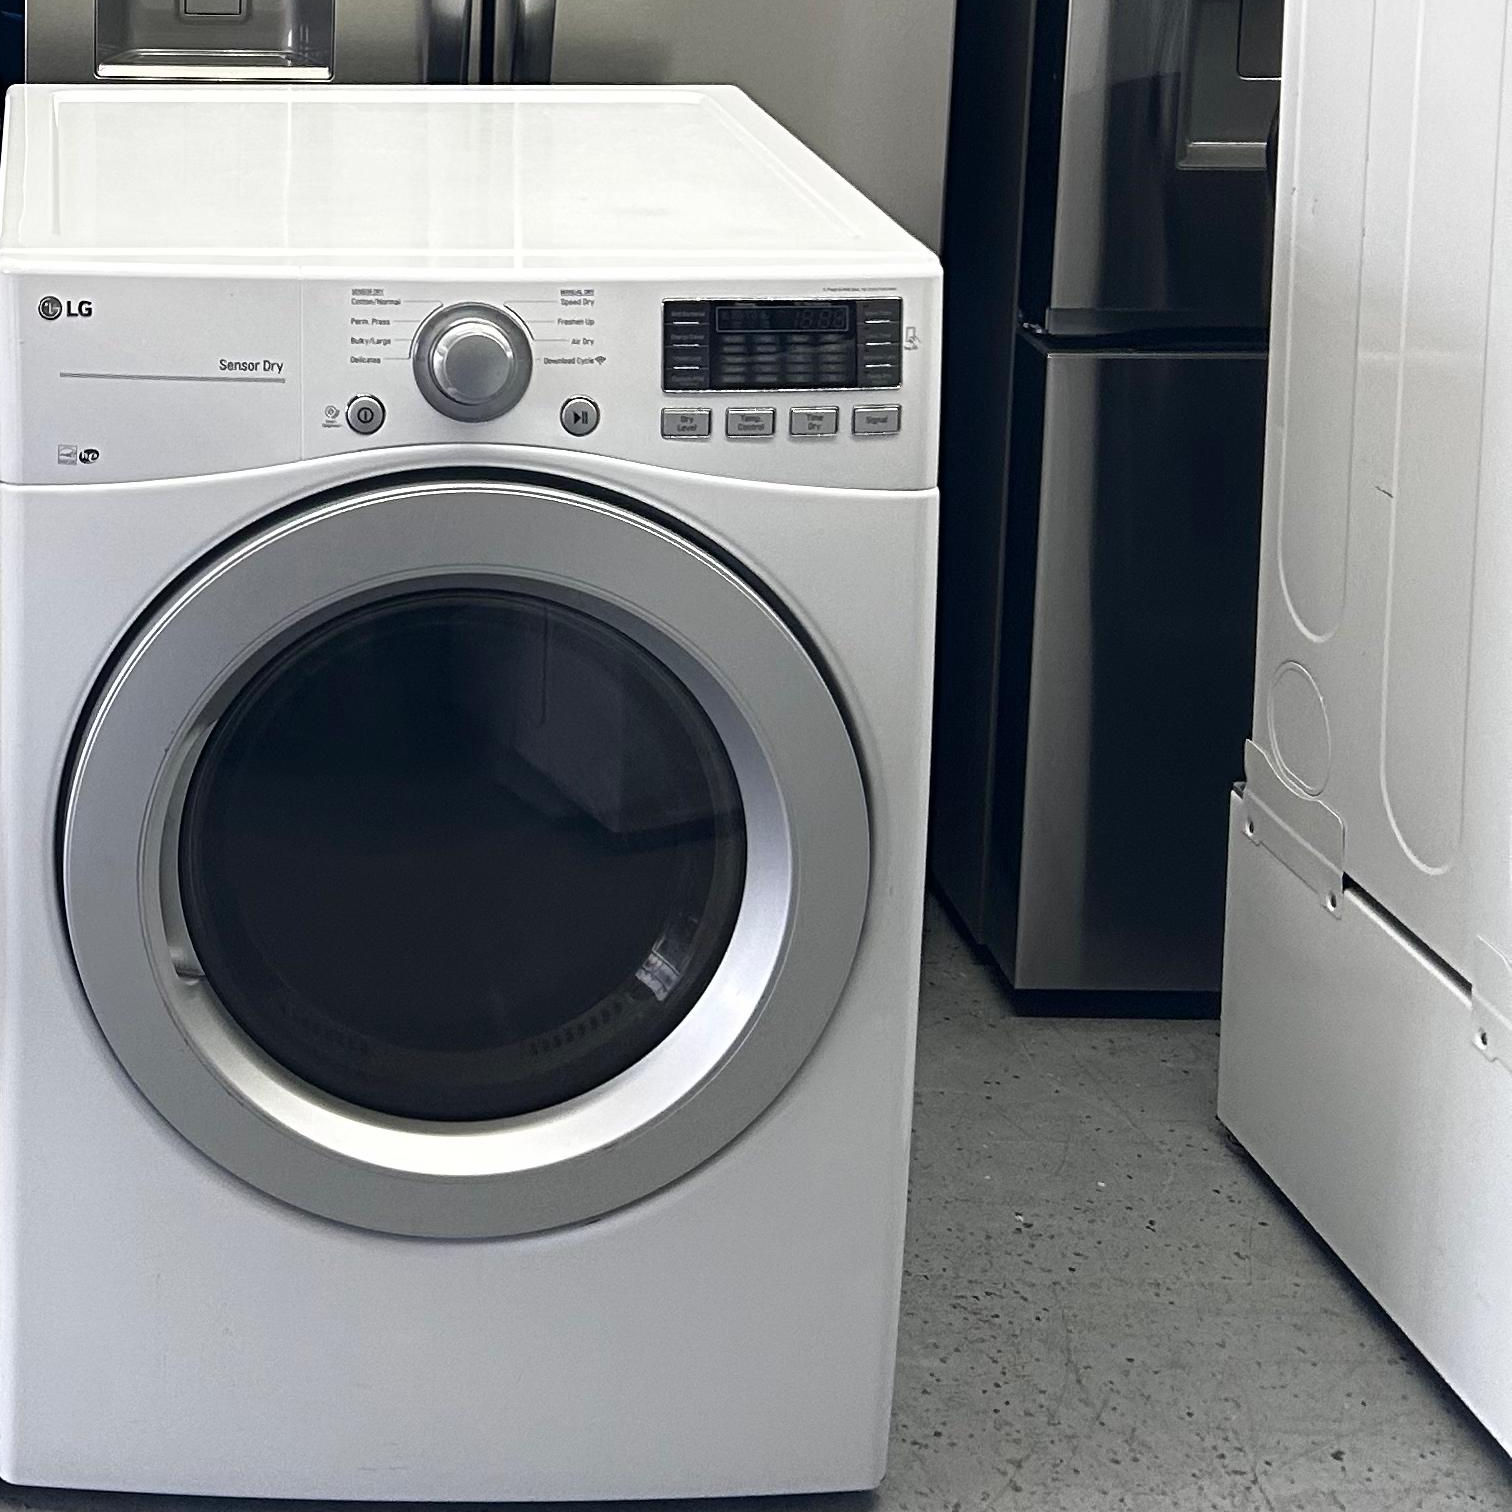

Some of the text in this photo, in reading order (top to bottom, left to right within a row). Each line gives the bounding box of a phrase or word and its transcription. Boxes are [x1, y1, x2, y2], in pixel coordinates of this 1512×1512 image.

[582, 298, 594, 307] Dry
[66, 300, 93, 317] LG
[372, 318, 390, 326] Press
[582, 338, 594, 346] Dry
[220, 359, 284, 374] Sensor Dry
[676, 424, 698, 432] Level
[738, 422, 765, 432] Control
